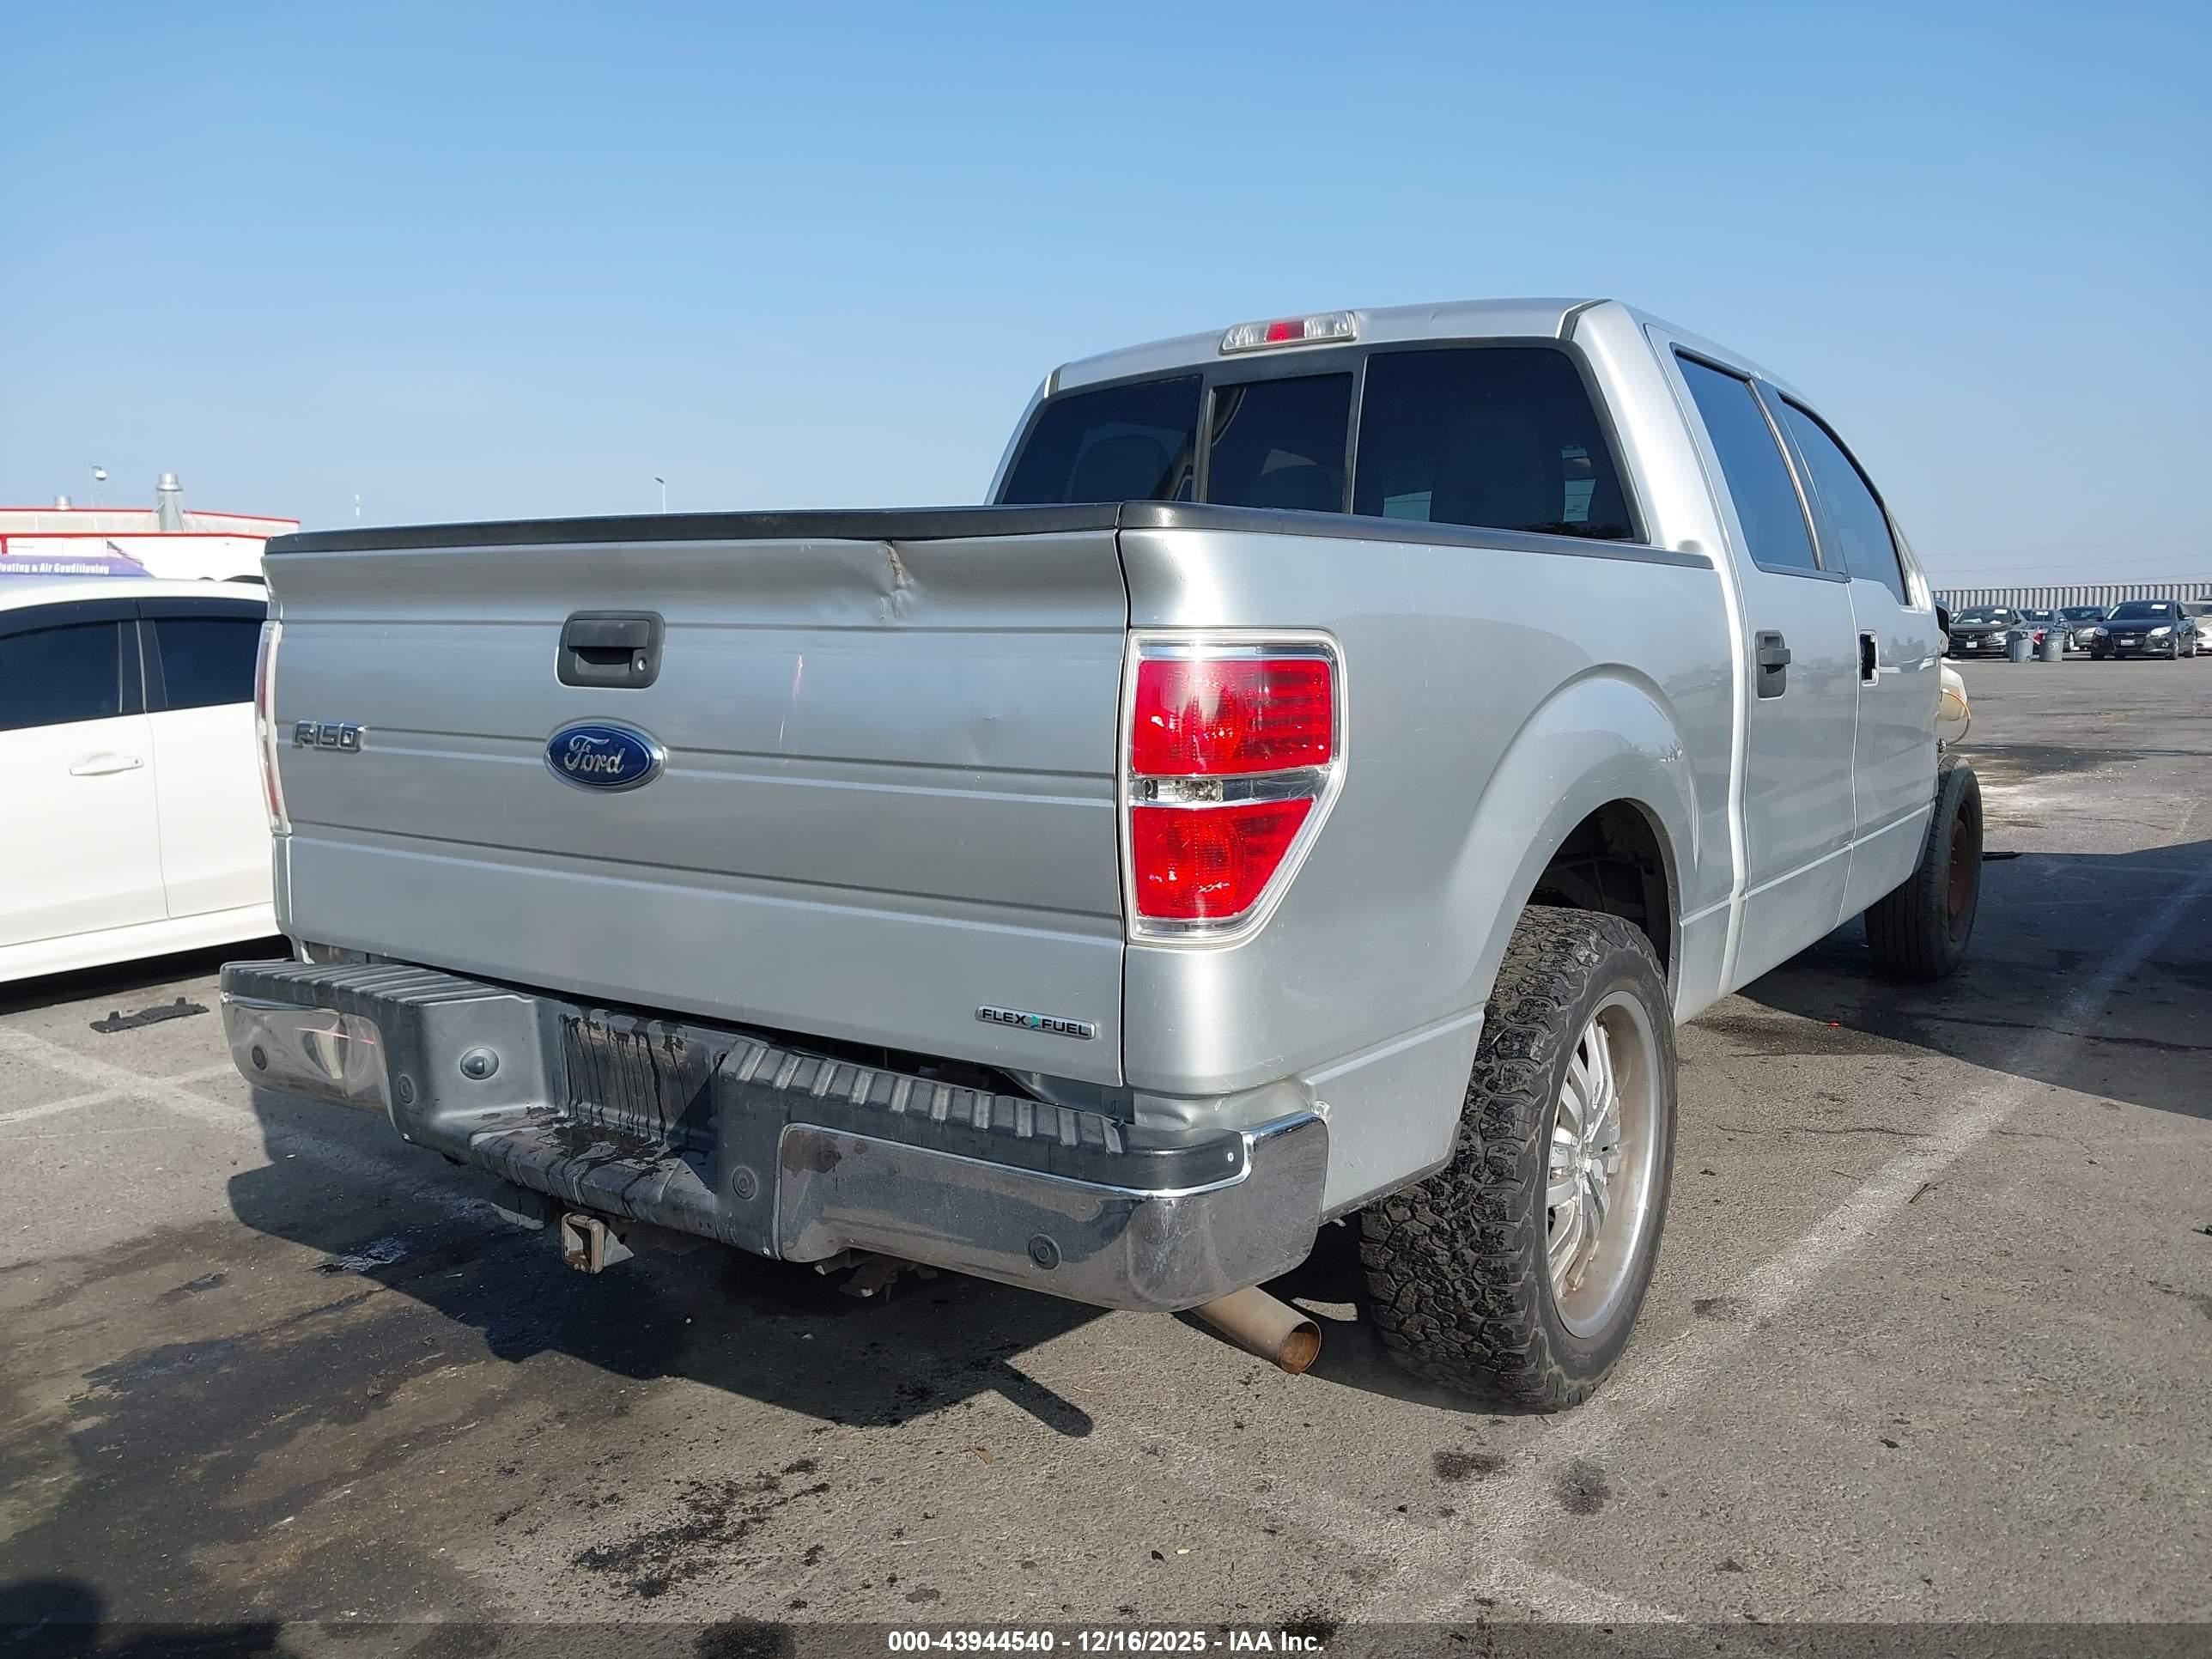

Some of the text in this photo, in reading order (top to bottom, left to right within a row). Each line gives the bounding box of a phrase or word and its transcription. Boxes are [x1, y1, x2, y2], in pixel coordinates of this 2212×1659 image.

[0, 562, 30, 573] eating
[40, 562, 52, 573] Air
[54, 562, 110, 574] Conditioning
[564, 735, 625, 774] Ford
[981, 1008, 1089, 1036] FLEX FUEL
